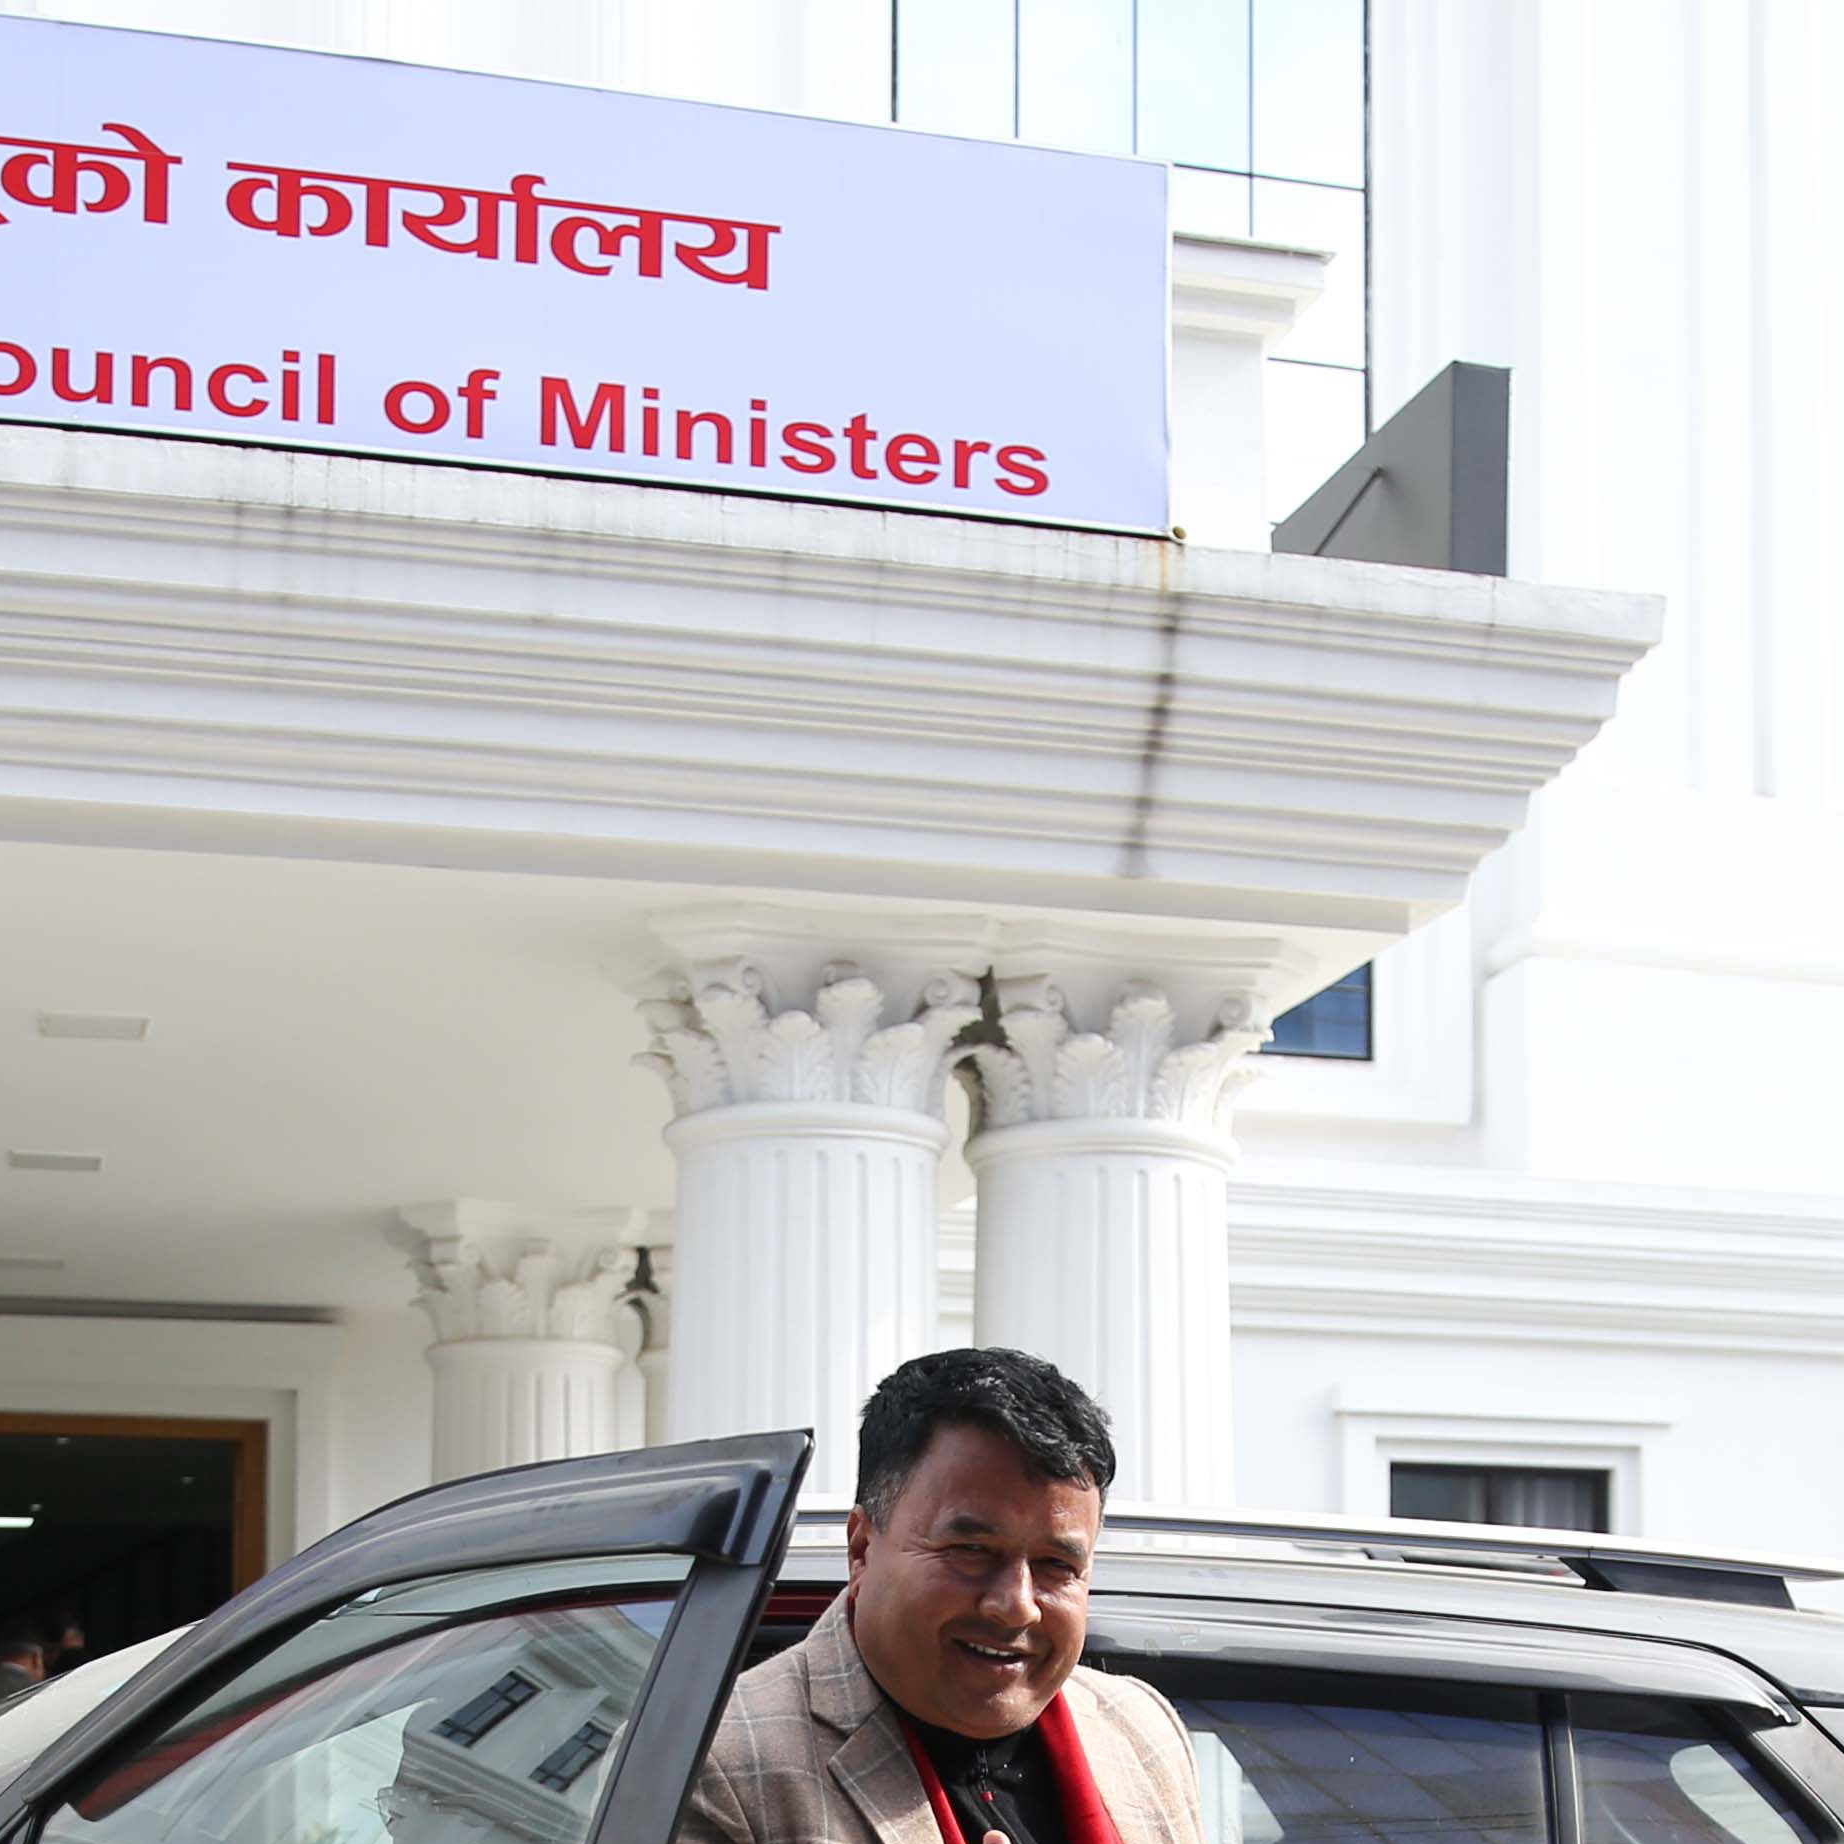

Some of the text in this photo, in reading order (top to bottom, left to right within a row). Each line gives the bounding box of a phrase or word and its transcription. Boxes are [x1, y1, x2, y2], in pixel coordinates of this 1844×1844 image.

[226, 161, 781, 291] कार्यालय
[384, 368, 501, 440] of
[540, 376, 1049, 497] Ministers
